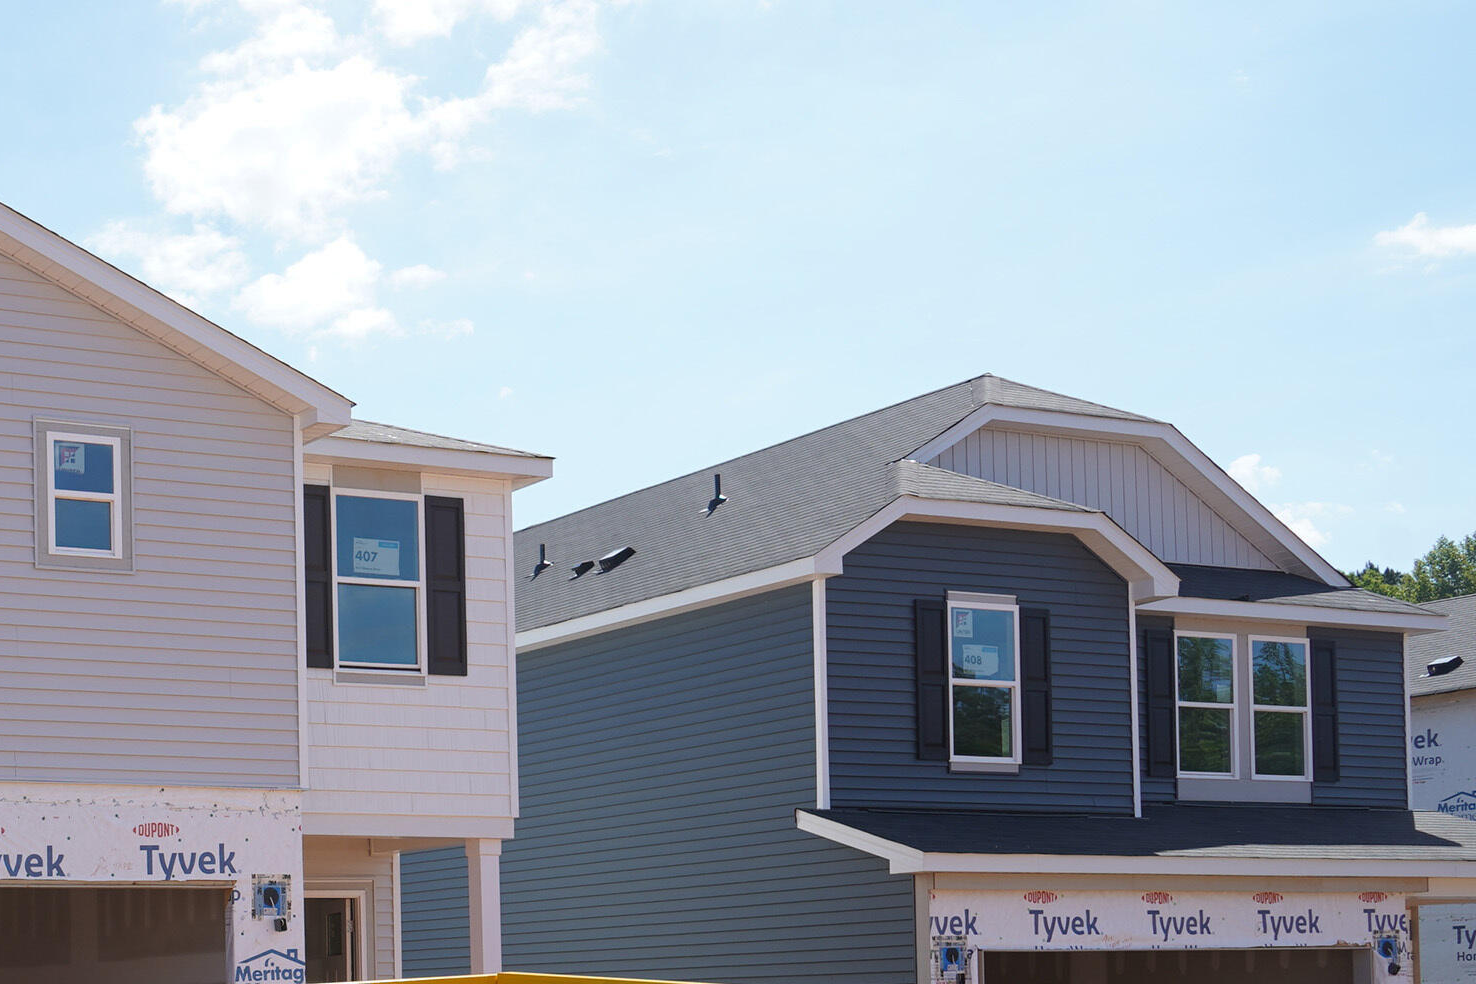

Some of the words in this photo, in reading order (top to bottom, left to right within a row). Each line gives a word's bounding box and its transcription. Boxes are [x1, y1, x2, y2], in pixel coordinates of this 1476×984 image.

[355, 550, 378, 562] 407
[964, 655, 982, 665] 408
[1412, 756, 1441, 766] Wrap
[1437, 798, 1476, 813] Merita
[138, 822, 175, 838] DUPONT
[140, 844, 236, 880] Tyvek
[1027, 891, 1055, 904] DUPONT
[1146, 891, 1170, 904] DUPONT
[1256, 892, 1280, 904] DUPONT
[1361, 891, 1385, 903] DUPONT
[929, 909, 978, 936] vek
[1029, 909, 1100, 942] Tyvek
[1147, 909, 1212, 941] Tyvek
[1258, 909, 1320, 940] Tyvek
[1363, 908, 1410, 937] Tyve
[235, 958, 305, 984] Meritag
